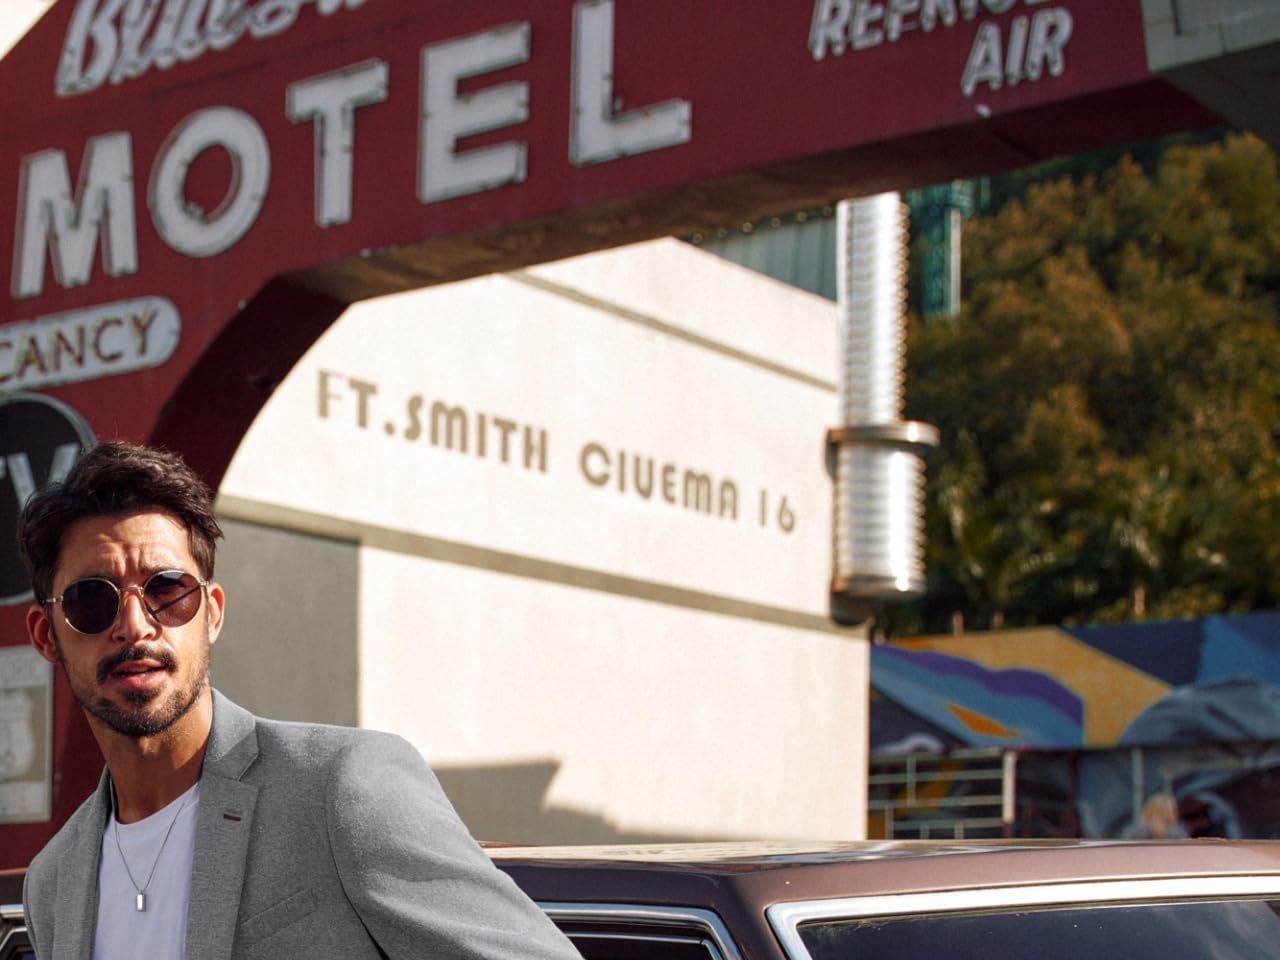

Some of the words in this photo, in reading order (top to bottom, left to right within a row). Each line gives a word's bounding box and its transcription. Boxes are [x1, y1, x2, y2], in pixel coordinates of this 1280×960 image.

[961, 8, 1073, 96] AIR
[11, 0, 692, 298] MOTEL
[758, 488, 797, 534] 16
